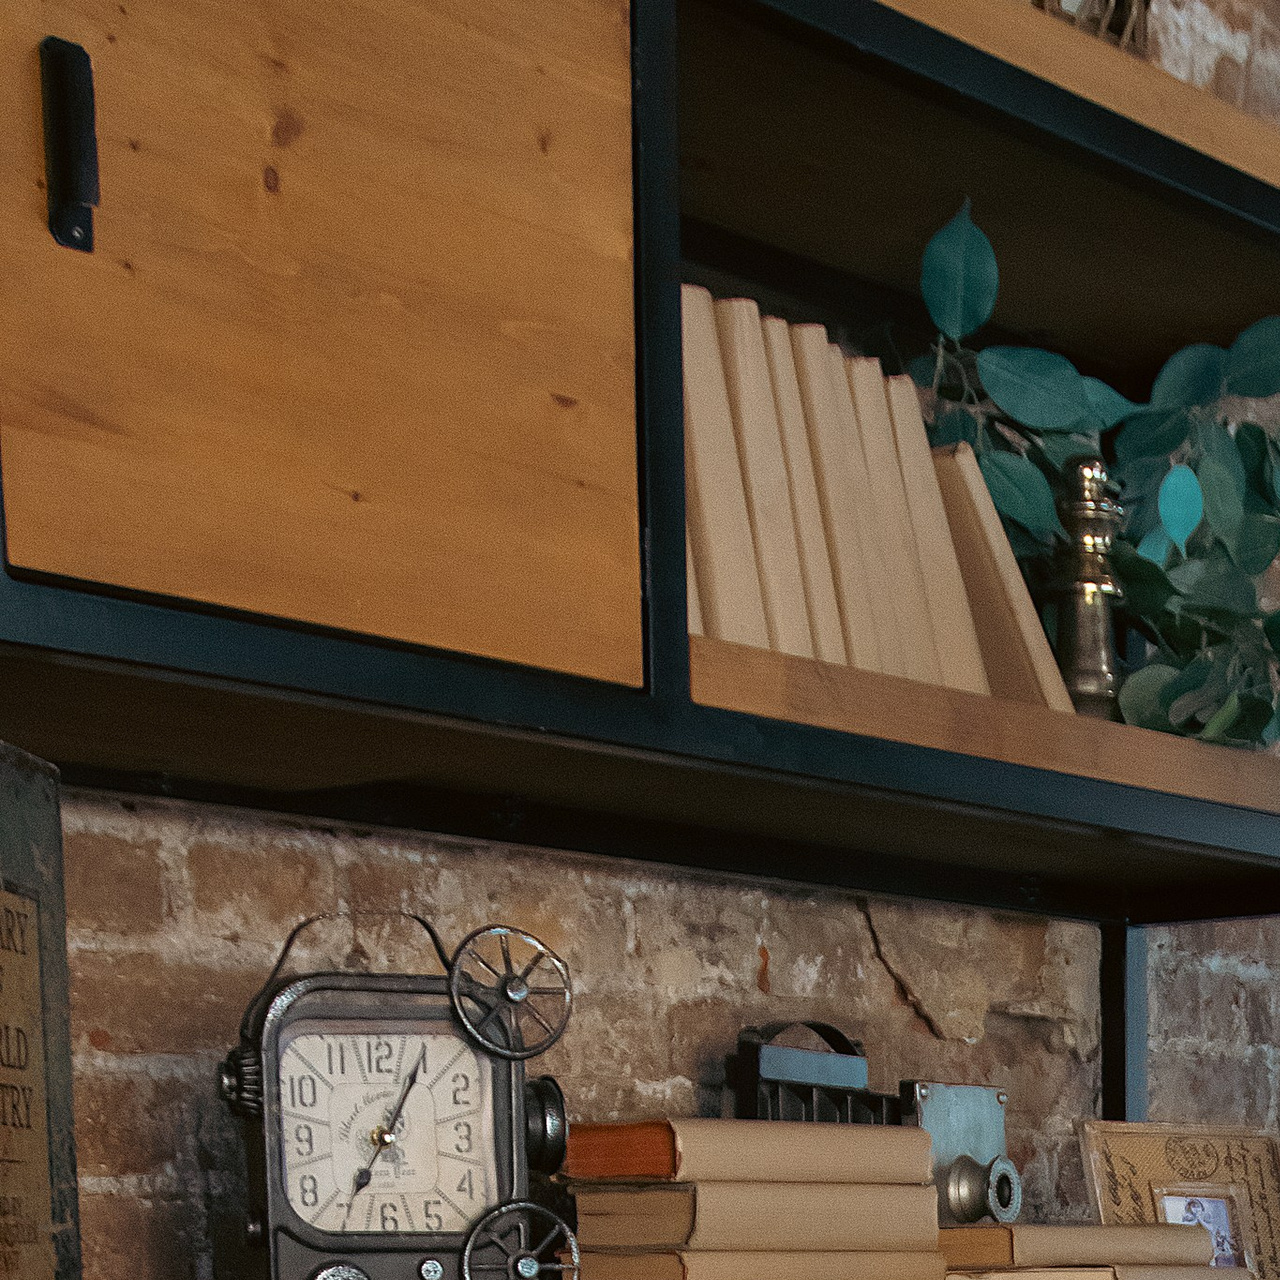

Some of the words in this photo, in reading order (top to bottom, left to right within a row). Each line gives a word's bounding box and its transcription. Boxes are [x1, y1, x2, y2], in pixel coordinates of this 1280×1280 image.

[0, 906, 28, 955] RY
[0, 1024, 28, 1070] LD
[327, 1042, 346, 1075] 11
[366, 1040, 393, 1074] 12
[289, 1074, 317, 1108] 10
[451, 1072, 470, 1106] 2
[295, 1123, 313, 1157] 9
[454, 1121, 472, 1154] 3
[299, 1174, 318, 1207] 8
[456, 1168, 474, 1200] 4
[380, 1202, 399, 1231] 6
[423, 1199, 443, 1231] 5
